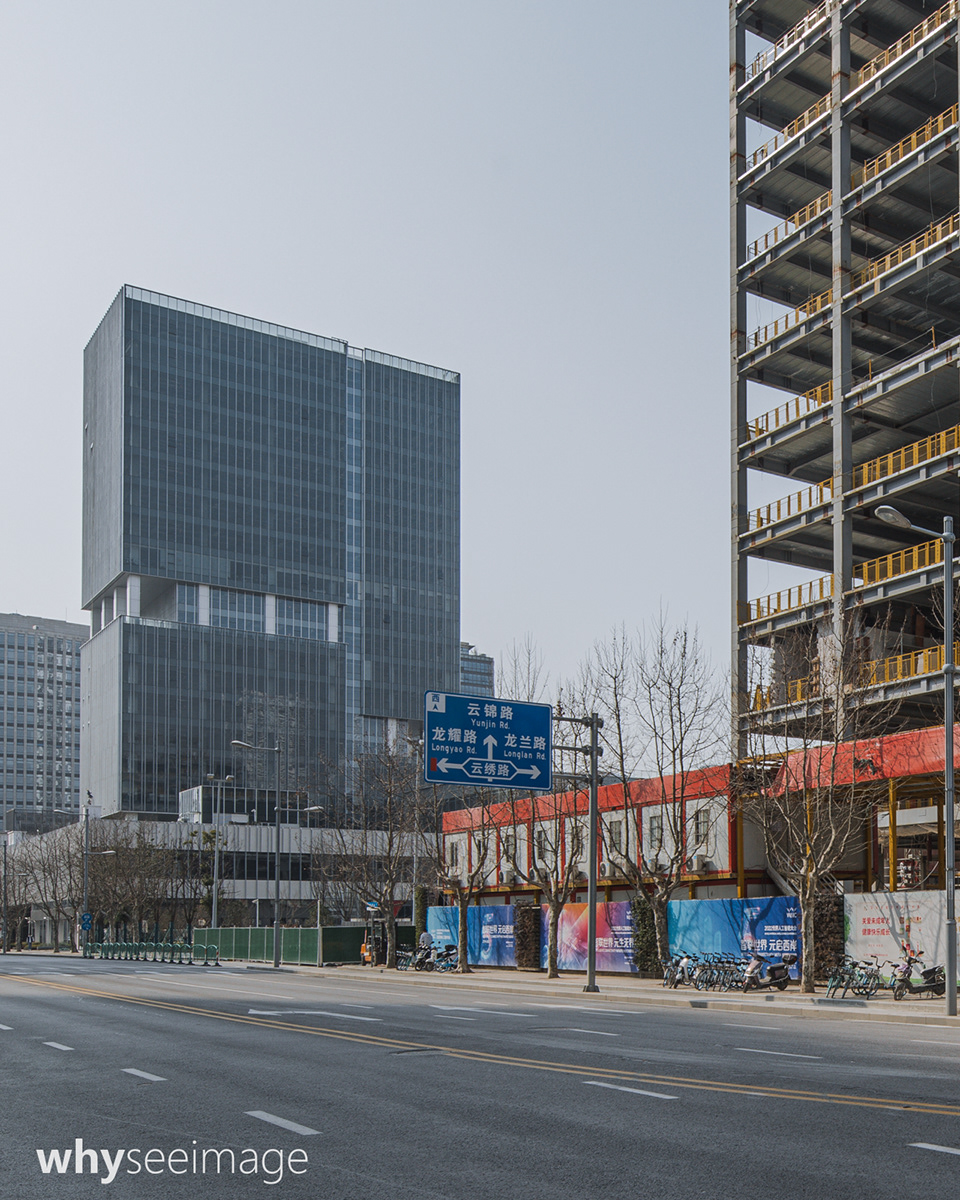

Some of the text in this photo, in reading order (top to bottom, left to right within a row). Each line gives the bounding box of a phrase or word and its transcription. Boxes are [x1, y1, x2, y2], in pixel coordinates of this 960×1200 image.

[432, 694, 440, 702] 西
[467, 703, 513, 720] 云锦路
[471, 718, 510, 729] Yunjin Rd.
[432, 727, 477, 744] 龙耀路
[504, 733, 546, 750] 龙兰路
[432, 743, 477, 754] Longyao Rd.
[471, 762, 509, 777] 云绣路
